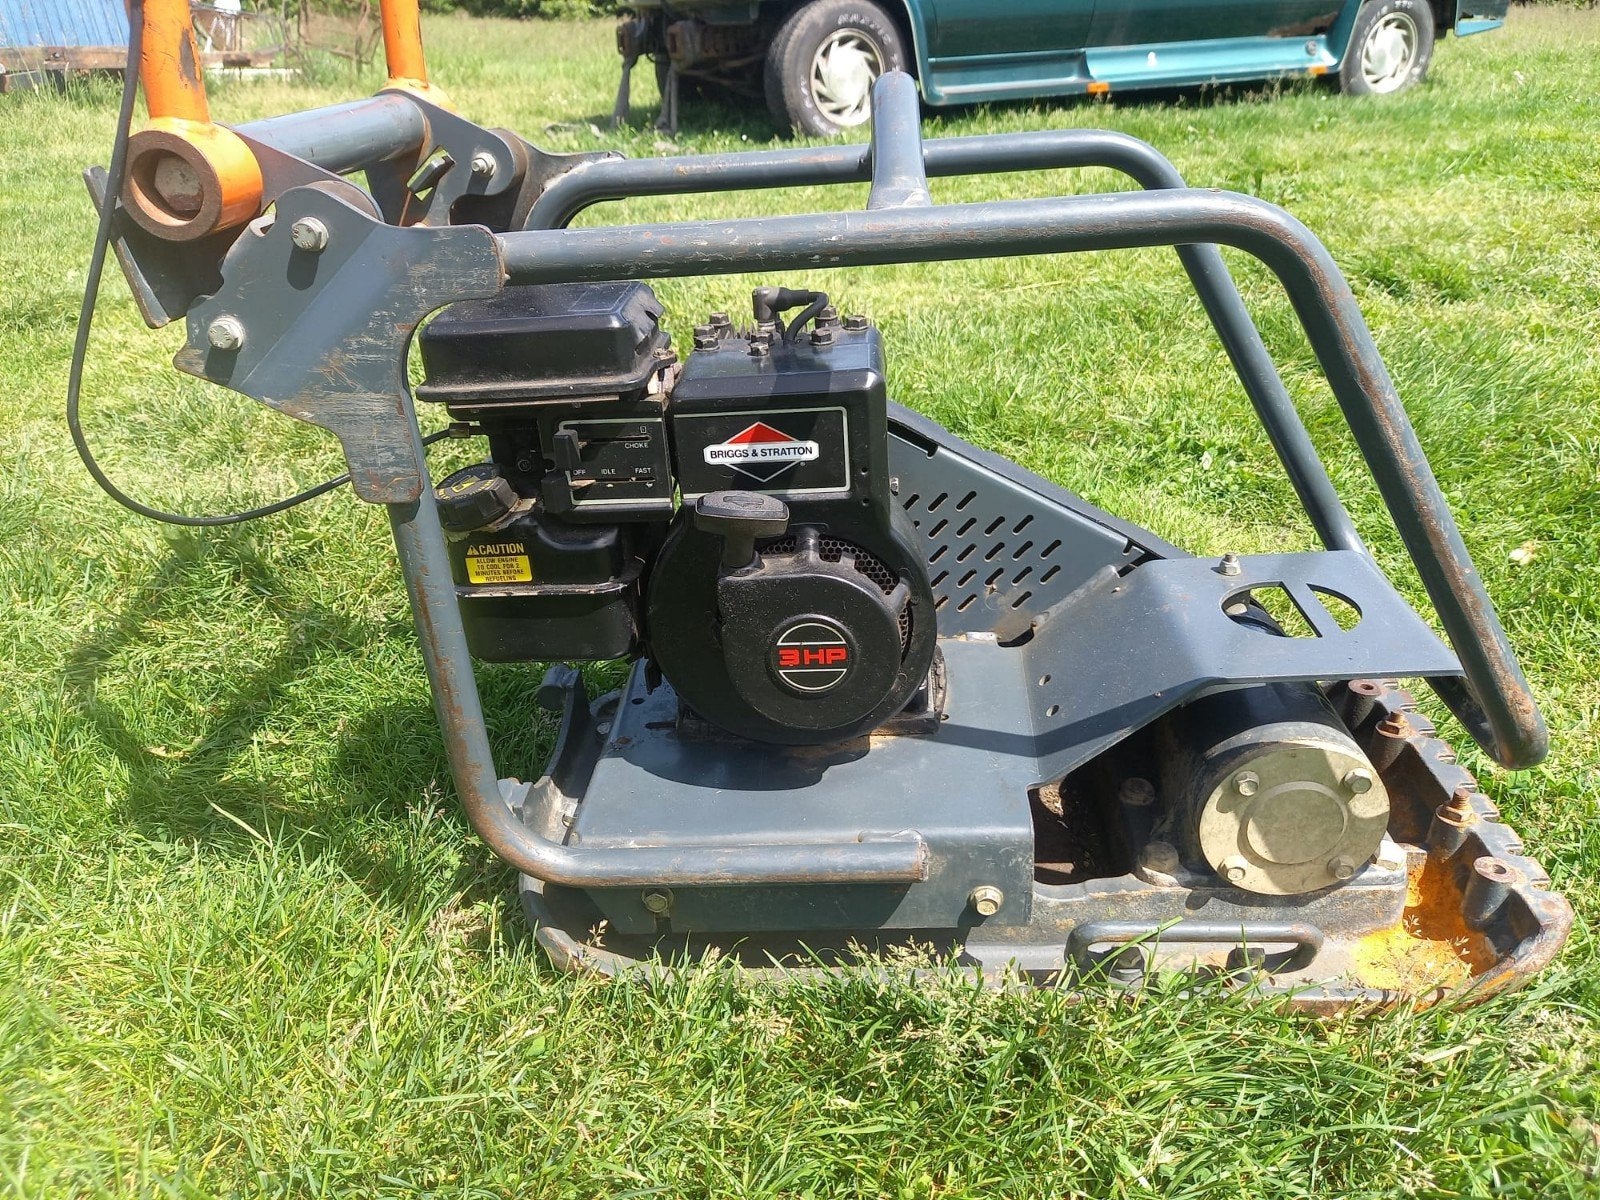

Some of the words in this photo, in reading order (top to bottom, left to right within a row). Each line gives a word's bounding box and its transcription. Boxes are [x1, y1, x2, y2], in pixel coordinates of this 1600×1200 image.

[710, 449, 749, 458] BRIGGS
[752, 448, 758, 457] &
[761, 446, 813, 457] STRATTON
[479, 543, 524, 555] CAUTION
